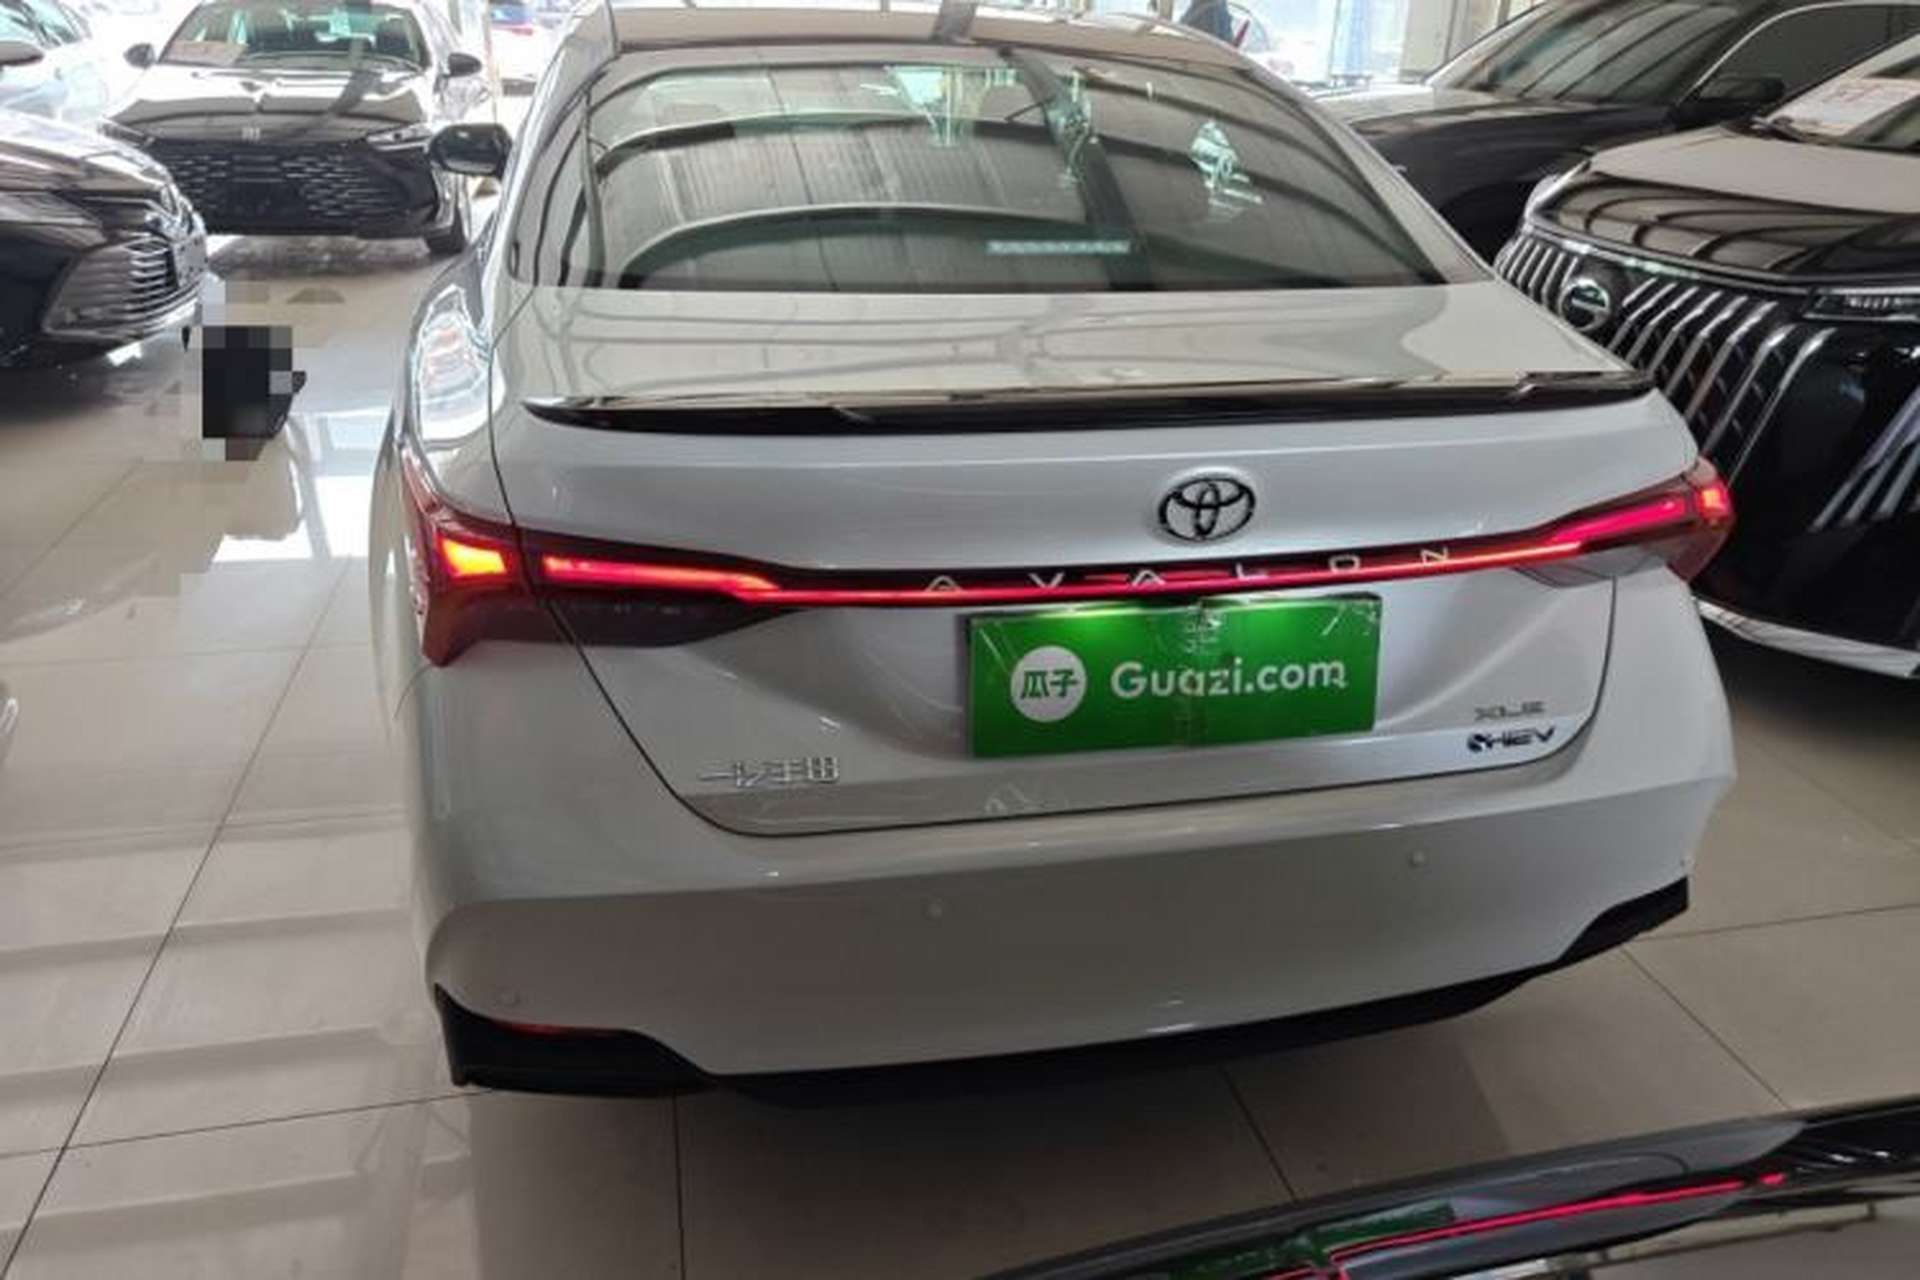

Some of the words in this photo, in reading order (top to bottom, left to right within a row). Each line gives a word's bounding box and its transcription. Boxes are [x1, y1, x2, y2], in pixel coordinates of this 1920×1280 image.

[924, 547, 1449, 594] AVALON
[1020, 668, 1079, 700] 瓜子
[1110, 656, 1348, 699] Guazi.com
